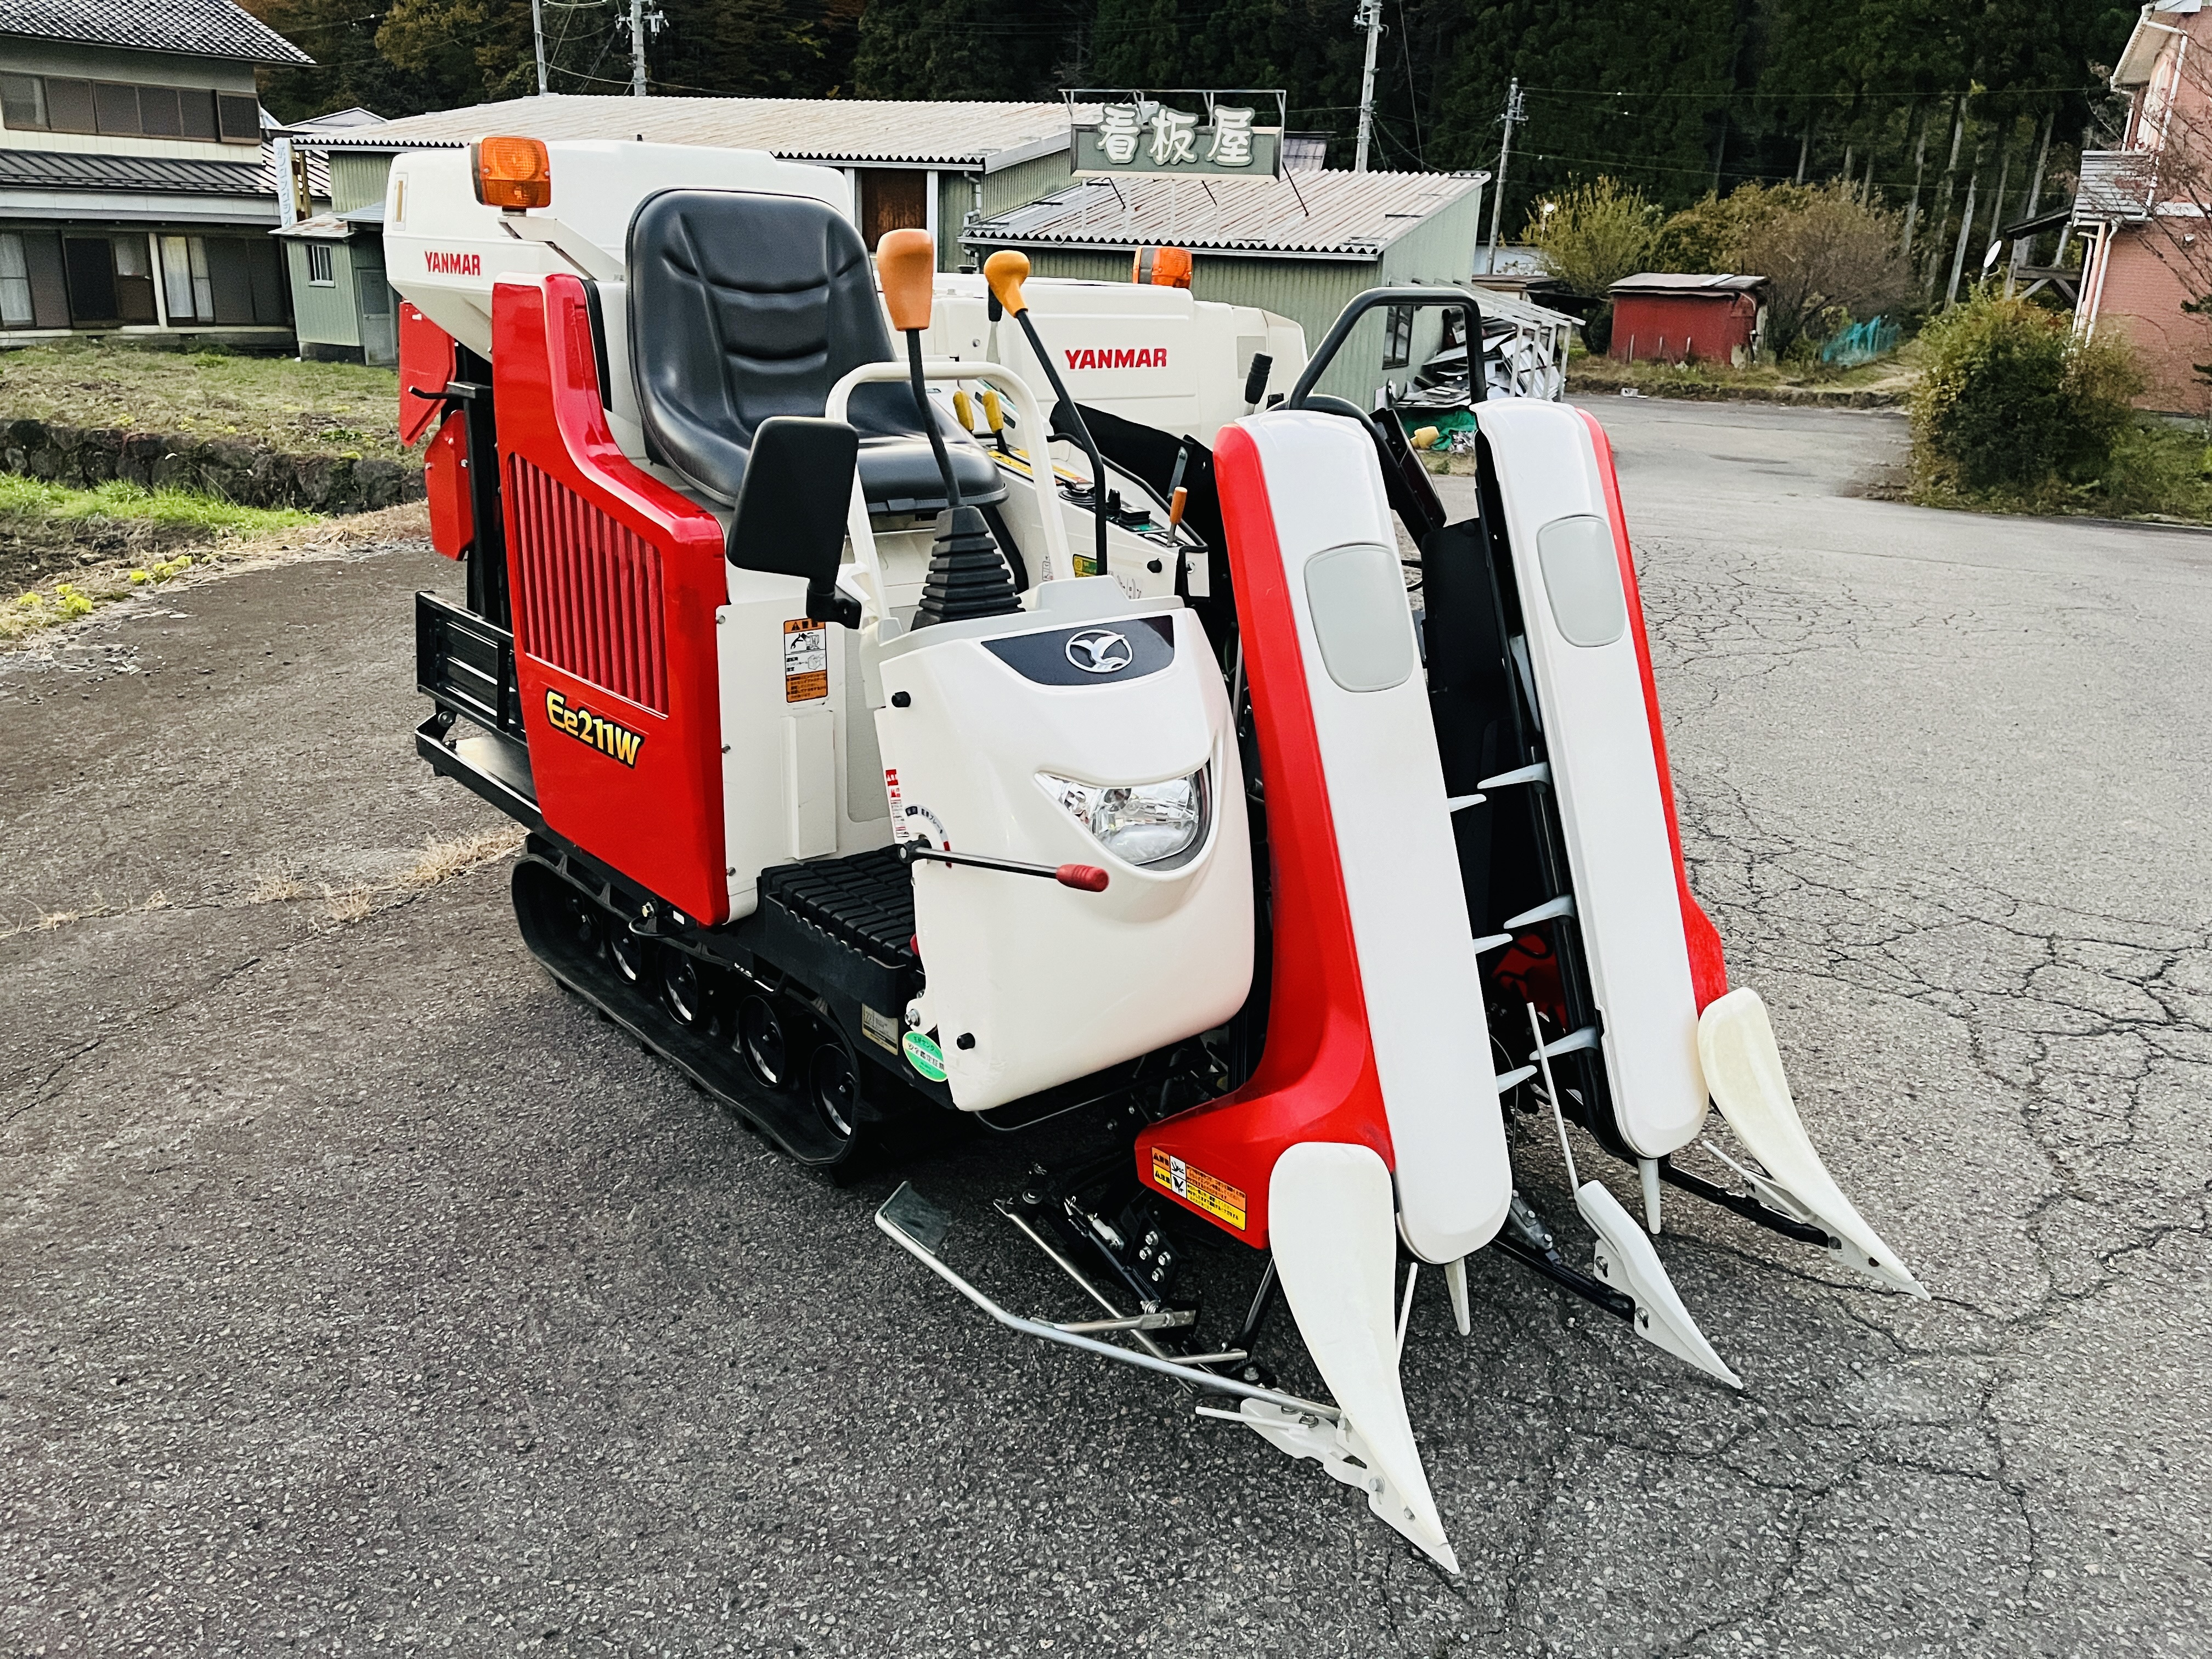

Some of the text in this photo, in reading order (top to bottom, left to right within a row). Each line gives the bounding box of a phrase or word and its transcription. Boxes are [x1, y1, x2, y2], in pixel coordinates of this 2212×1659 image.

[1098, 105, 1253, 165] 看板屋
[424, 251, 481, 276] YANMAR
[1064, 348, 1167, 370] YANMAR
[546, 690, 642, 766] Ee211W
